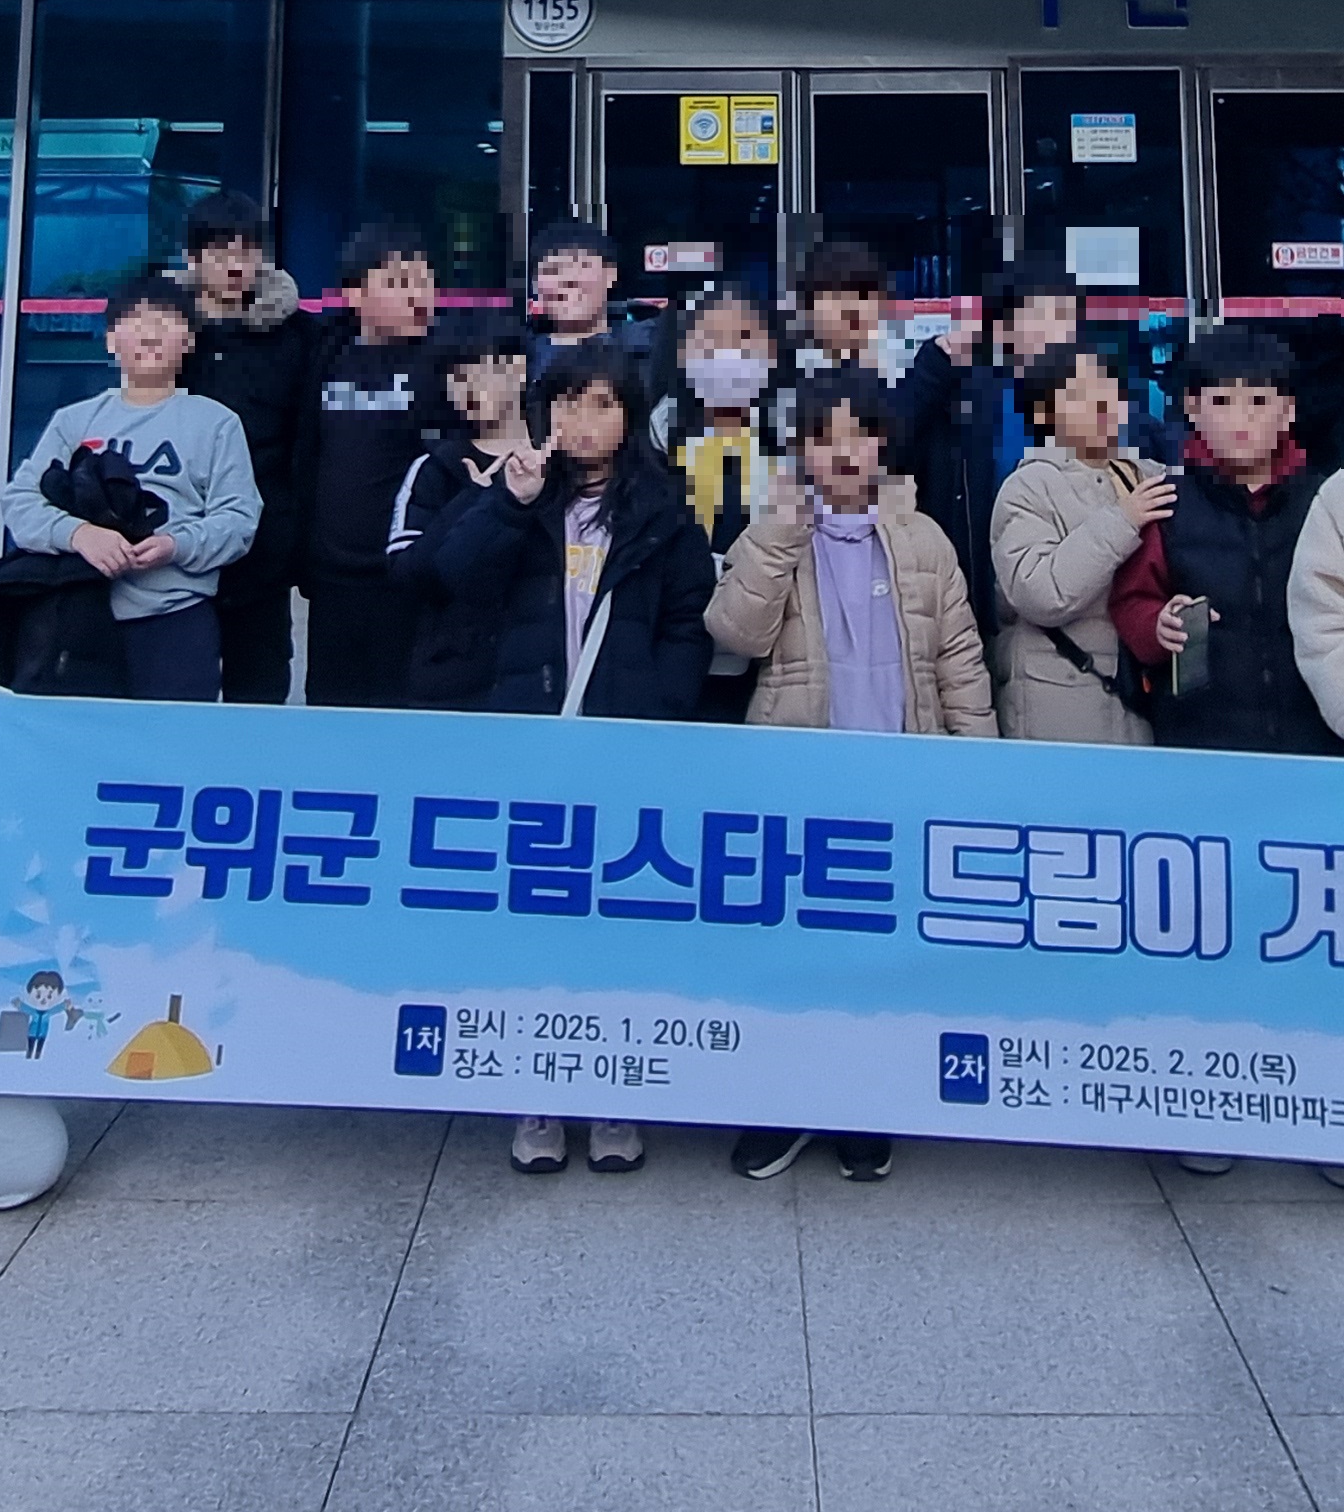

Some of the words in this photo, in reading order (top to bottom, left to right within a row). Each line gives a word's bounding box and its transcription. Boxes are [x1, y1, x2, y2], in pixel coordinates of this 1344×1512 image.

[83, 782, 380, 906] 군위군
[400, 795, 898, 934] 드림스타트
[918, 819, 1233, 959] 드림이
[403, 1026, 442, 1055] 1차
[456, 1008, 506, 1039] 일시
[533, 1013, 607, 1043] 2025.
[620, 1017, 642, 1045] 1.
[452, 1048, 503, 1079] 장소
[533, 1052, 584, 1083] 대구
[594, 1054, 671, 1086] 이월드
[944, 1054, 985, 1084] 2차
[999, 1038, 1051, 1068] 일시
[1080, 1044, 1157, 1075] 2025.
[1168, 1049, 1193, 1077] 2.
[999, 1077, 1052, 1108] 장소
